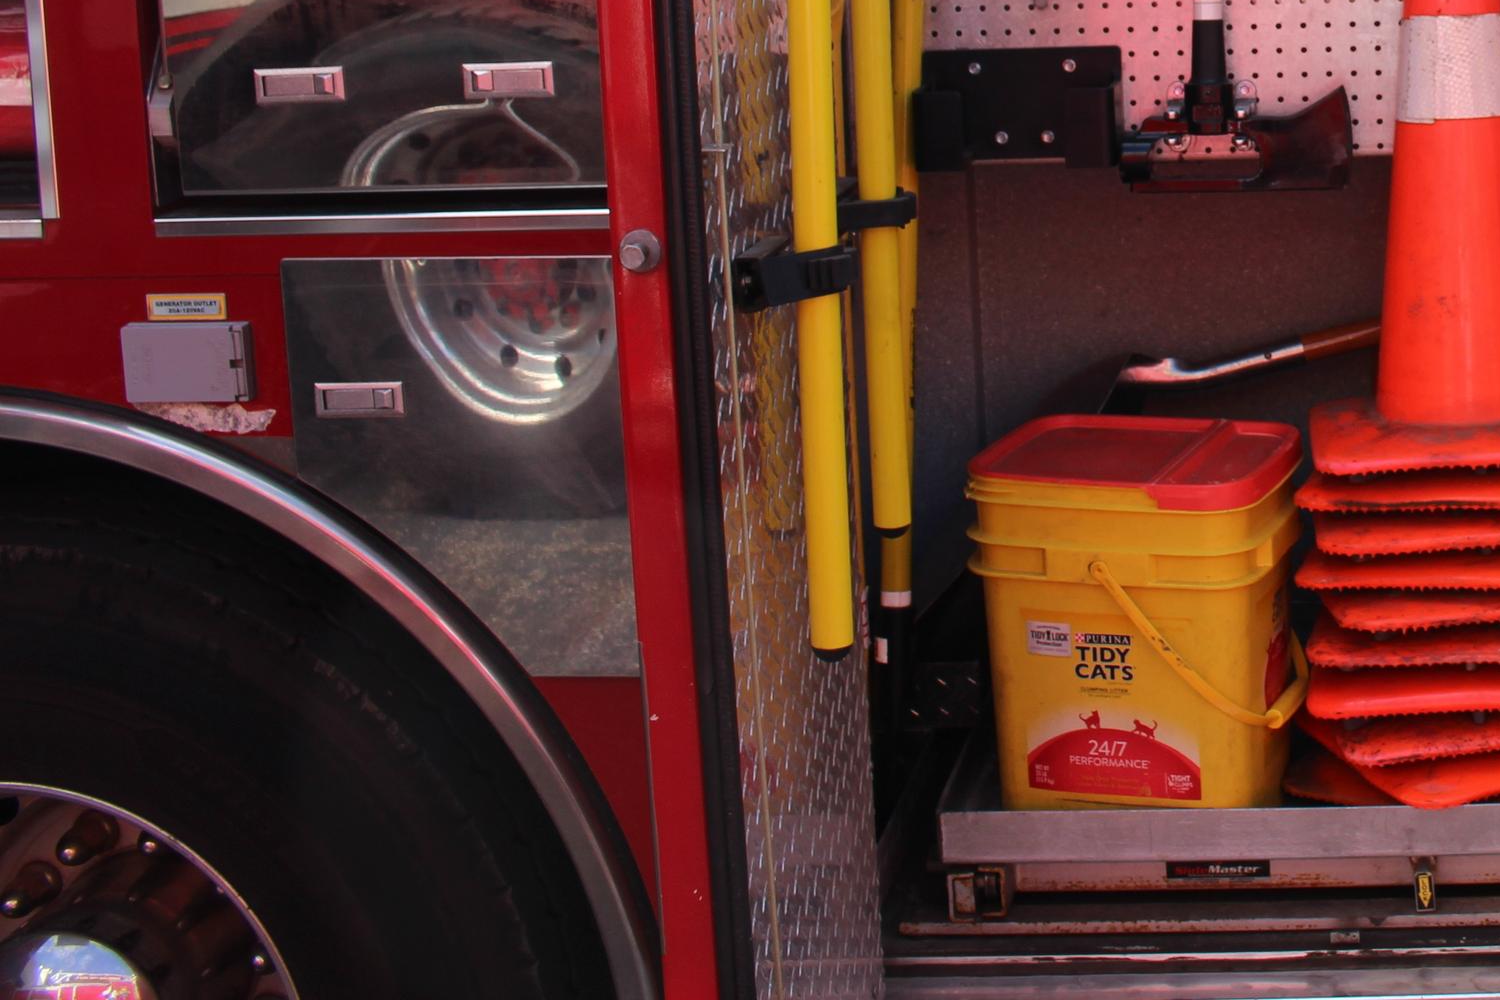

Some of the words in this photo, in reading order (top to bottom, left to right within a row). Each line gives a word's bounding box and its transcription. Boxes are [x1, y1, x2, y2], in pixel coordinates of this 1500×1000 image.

[1085, 634, 1131, 645] PURINA
[1075, 646, 1130, 663] TIDY
[1074, 663, 1134, 681] CATS
[1088, 739, 1128, 757] 24/7
[1069, 755, 1149, 770] PERFORMANCE
